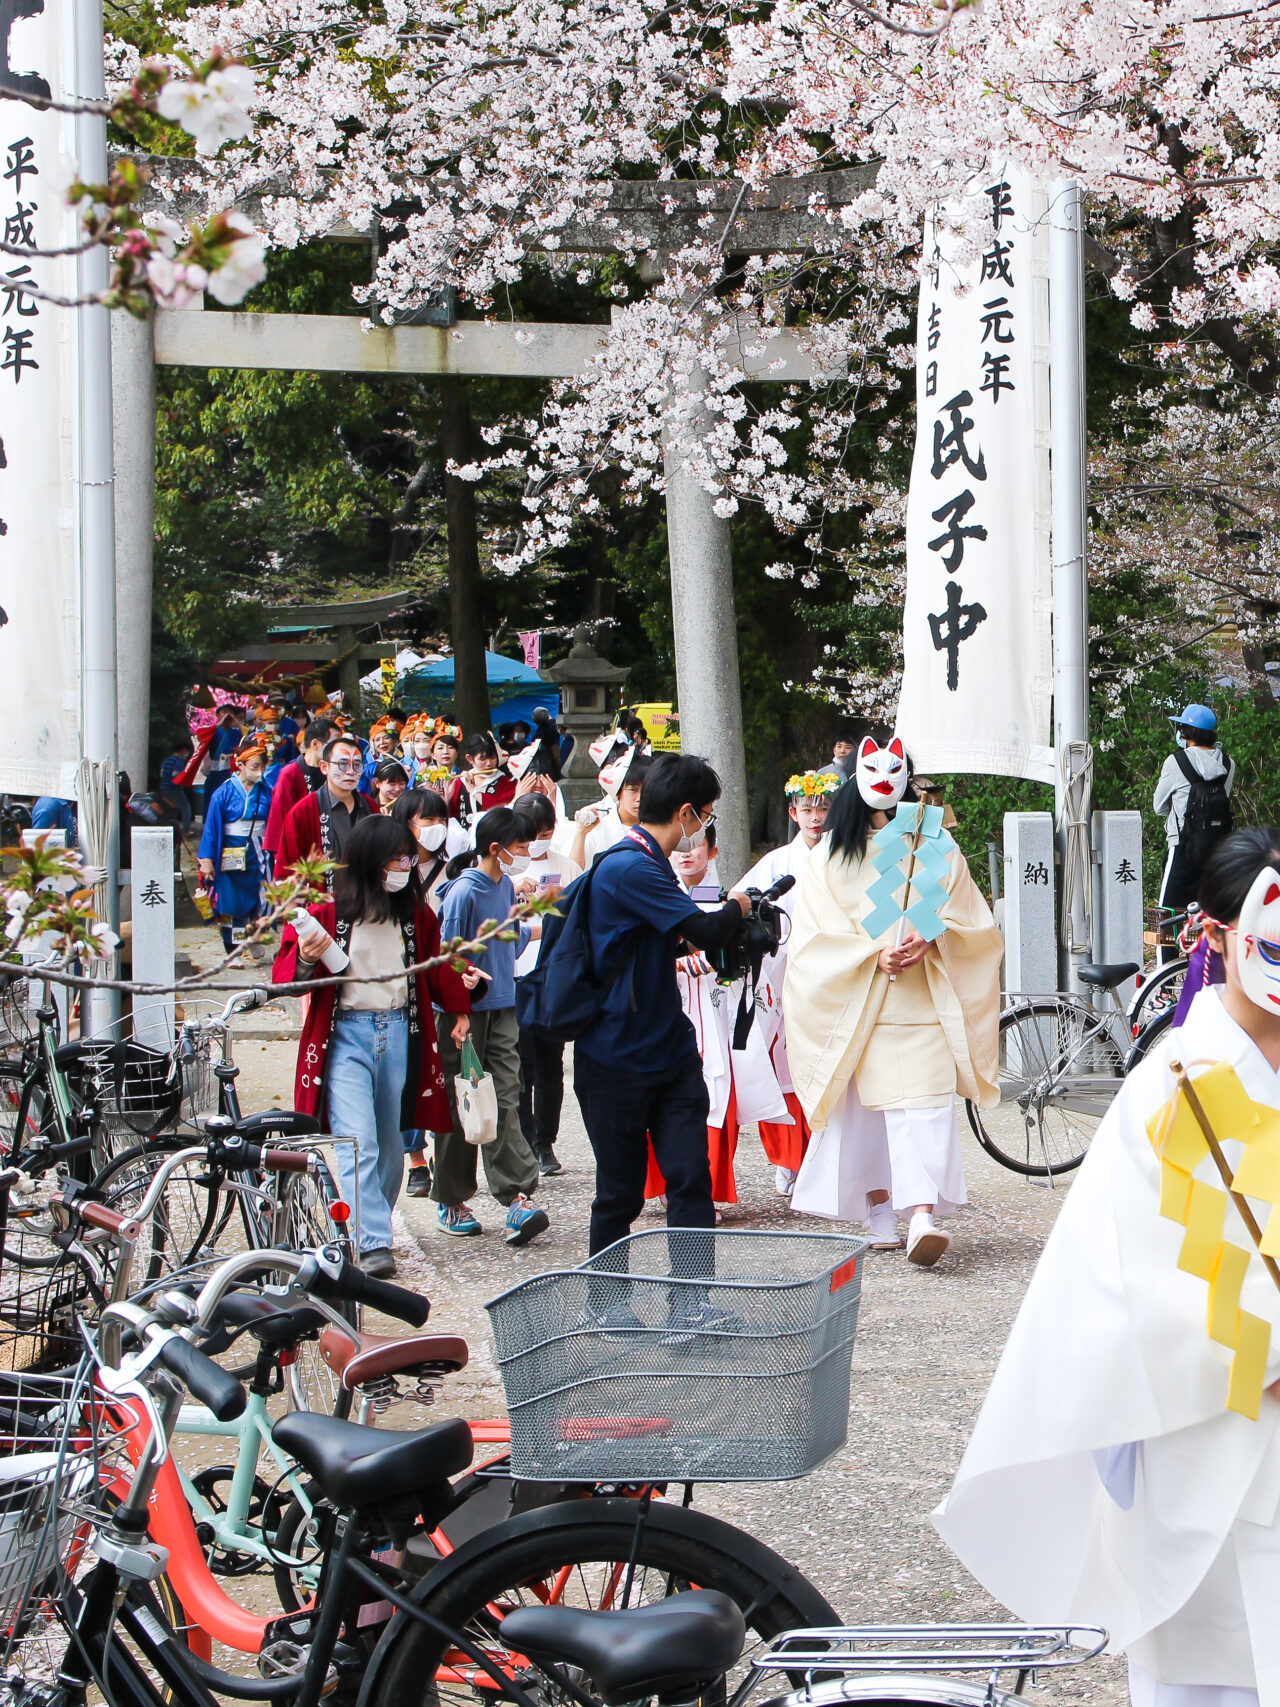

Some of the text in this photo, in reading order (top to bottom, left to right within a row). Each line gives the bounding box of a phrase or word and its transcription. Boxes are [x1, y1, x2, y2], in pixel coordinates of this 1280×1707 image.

[1, 136, 40, 385] 平成元年
[979, 181, 1016, 405] 平成元年
[927, 390, 988, 692] 氏子中
[140, 880, 167, 909] 奉
[1023, 862, 1049, 886] 納
[1114, 859, 1138, 885] 奉
